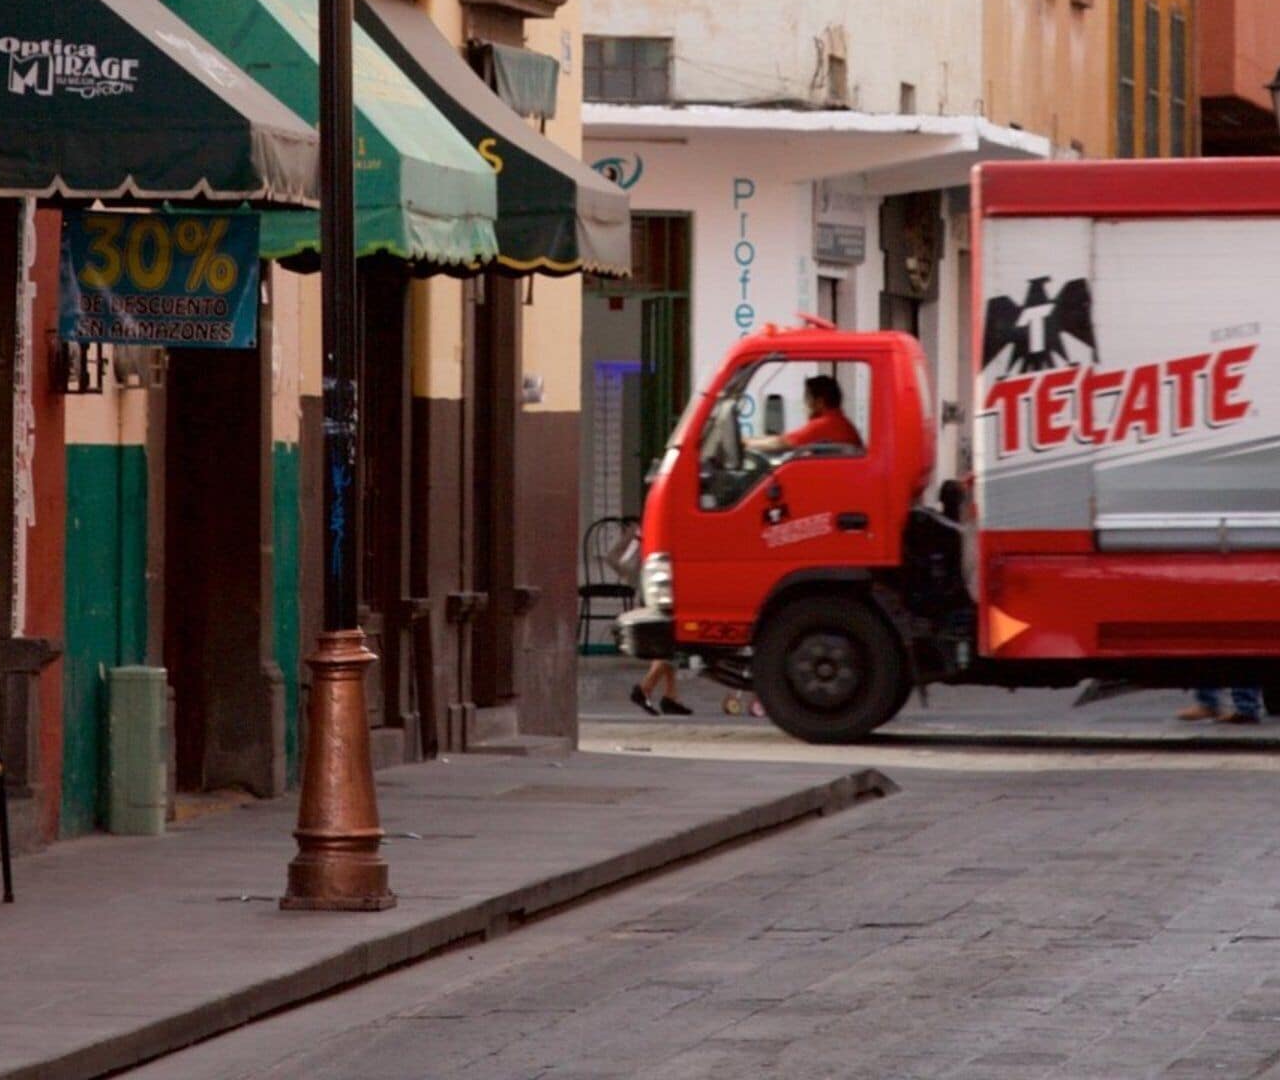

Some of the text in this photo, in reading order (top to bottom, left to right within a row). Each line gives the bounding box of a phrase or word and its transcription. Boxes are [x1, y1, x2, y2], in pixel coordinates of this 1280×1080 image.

[8, 53, 139, 96] MIRAGE
[78, 216, 239, 294] 30%
[982, 343, 1260, 453] TECATE
